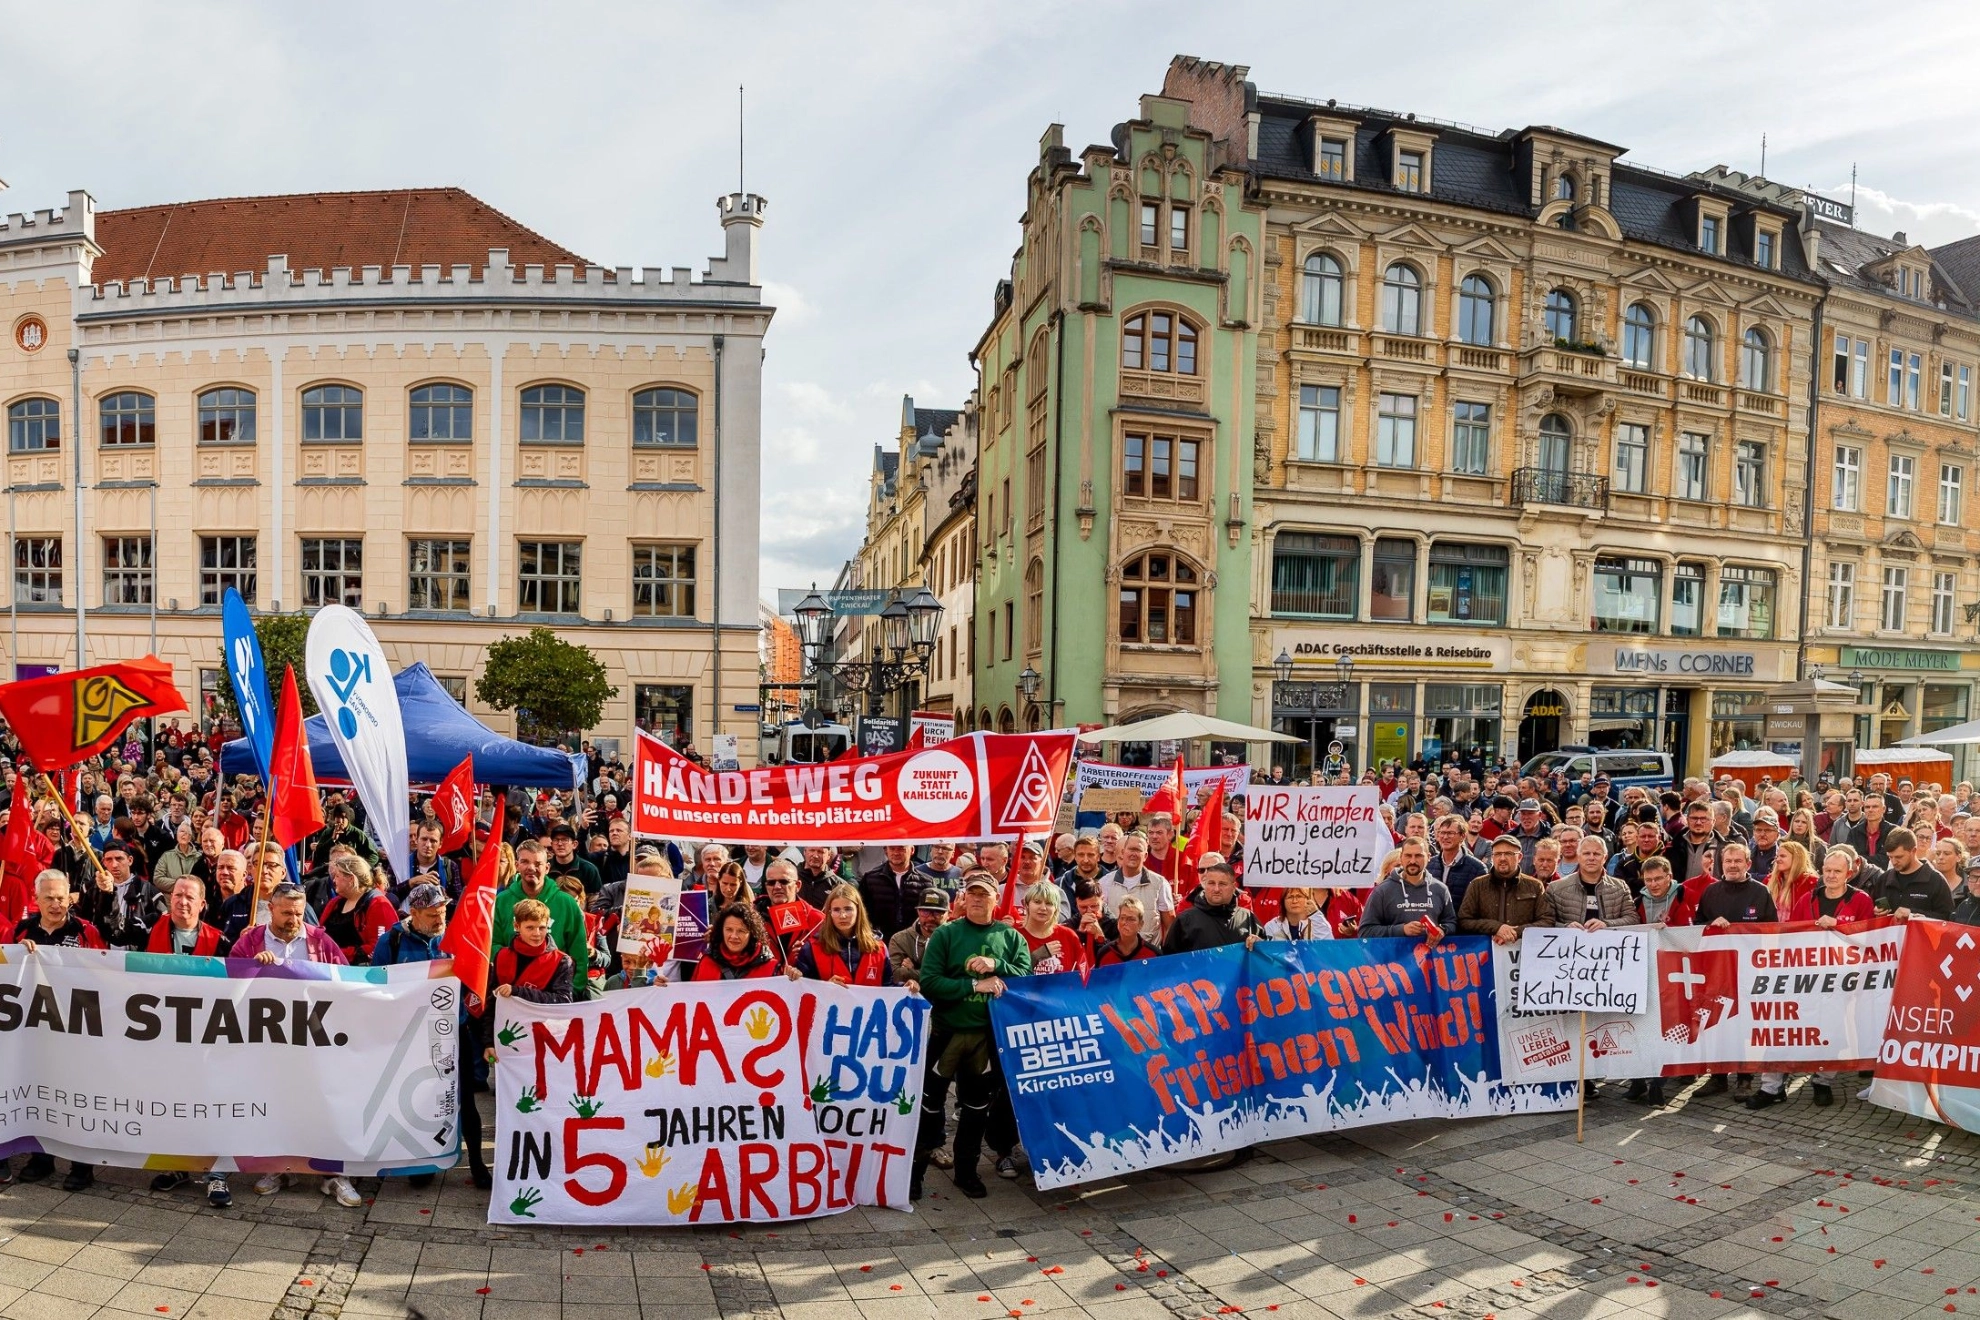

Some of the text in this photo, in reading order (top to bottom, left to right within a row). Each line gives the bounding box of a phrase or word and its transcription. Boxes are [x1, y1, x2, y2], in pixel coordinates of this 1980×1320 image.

[1294, 642, 1492, 659] ADAC Geschäftsstelle & Reisebüro
[1679, 653, 1754, 673] CORNER
[1854, 650, 1949, 669] MODE MEYER
[1530, 705, 1563, 716] ADAC
[865, 730, 895, 747] BASS
[924, 728, 945, 736] URCH
[643, 758, 883, 806] HÄNDE WEG
[912, 770, 958, 780] ZUKUNFT
[920, 780, 951, 790] STATT
[1081, 775, 1110, 786] GEGEN
[903, 790, 969, 801] KAHLSCHLAG
[642, 803, 892, 828] von unseren Arbeitsplätzen!
[1245, 793, 1375, 825] WIR kämpfen
[1262, 822, 1357, 845] um jeden
[1247, 847, 1373, 880] Arbeitsplatz
[1537, 933, 1641, 972] Zukunft
[1751, 941, 1898, 969] GEMEINSAM
[1750, 969, 1898, 995] BEWEGEN
[1099, 943, 1489, 1054] WIR sorgen für
[1523, 981, 1637, 1015] Kahlschlag
[1750, 1001, 1799, 1021] WIR
[125, 993, 349, 1047] STARK.
[823, 995, 931, 1065] HAST
[1005, 1013, 1105, 1049] MAHLE
[1887, 1005, 1953, 1035] NSER
[1517, 1027, 1554, 1045] UNSER
[1522, 1036, 1557, 1054] LEBEN
[1751, 1027, 1830, 1047] MEHR.
[1020, 1038, 1102, 1071] BEHR
[1146, 991, 1486, 1116] frischen Wind!
[1526, 1042, 1568, 1065] gestalten
[1546, 1052, 1572, 1067] WIR!
[1877, 1038, 1980, 1073] OCKPIT
[828, 1055, 907, 1104] DU
[1017, 1069, 1115, 1095] Kirchberg
[507, 1131, 551, 1181] IN
[563, 1117, 628, 1207] 5
[644, 1105, 785, 1149] JAHREN
[688, 1139, 906, 1223] ARBEIT
